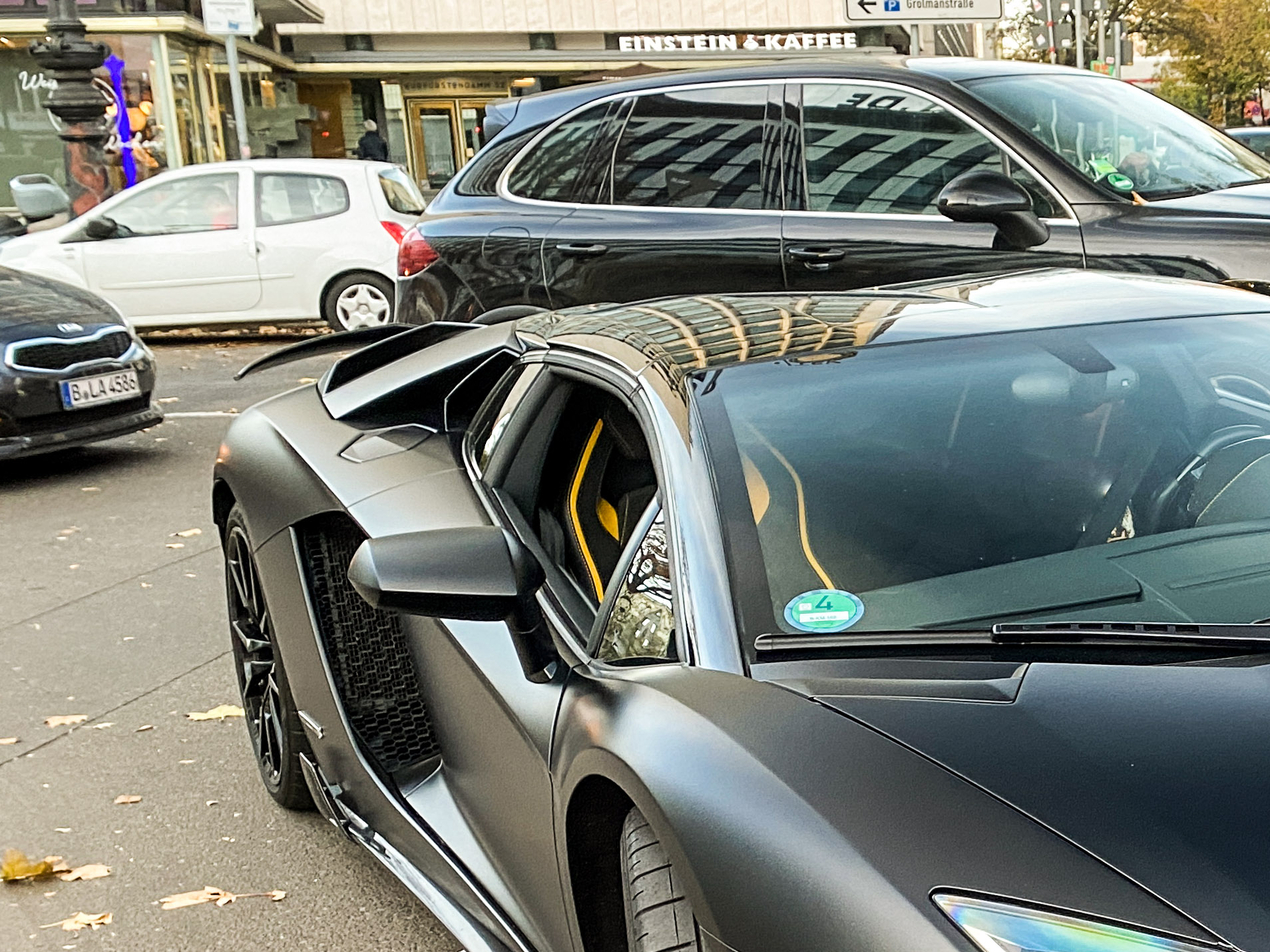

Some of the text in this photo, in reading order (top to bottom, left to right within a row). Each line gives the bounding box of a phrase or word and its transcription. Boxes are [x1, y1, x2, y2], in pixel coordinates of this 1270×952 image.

[618, 35, 737, 52] EINSTEIN
[765, 33, 857, 50] KAFFEE
[71, 383, 81, 401] B
[88, 379, 107, 398] LA
[815, 595, 834, 610] 4
